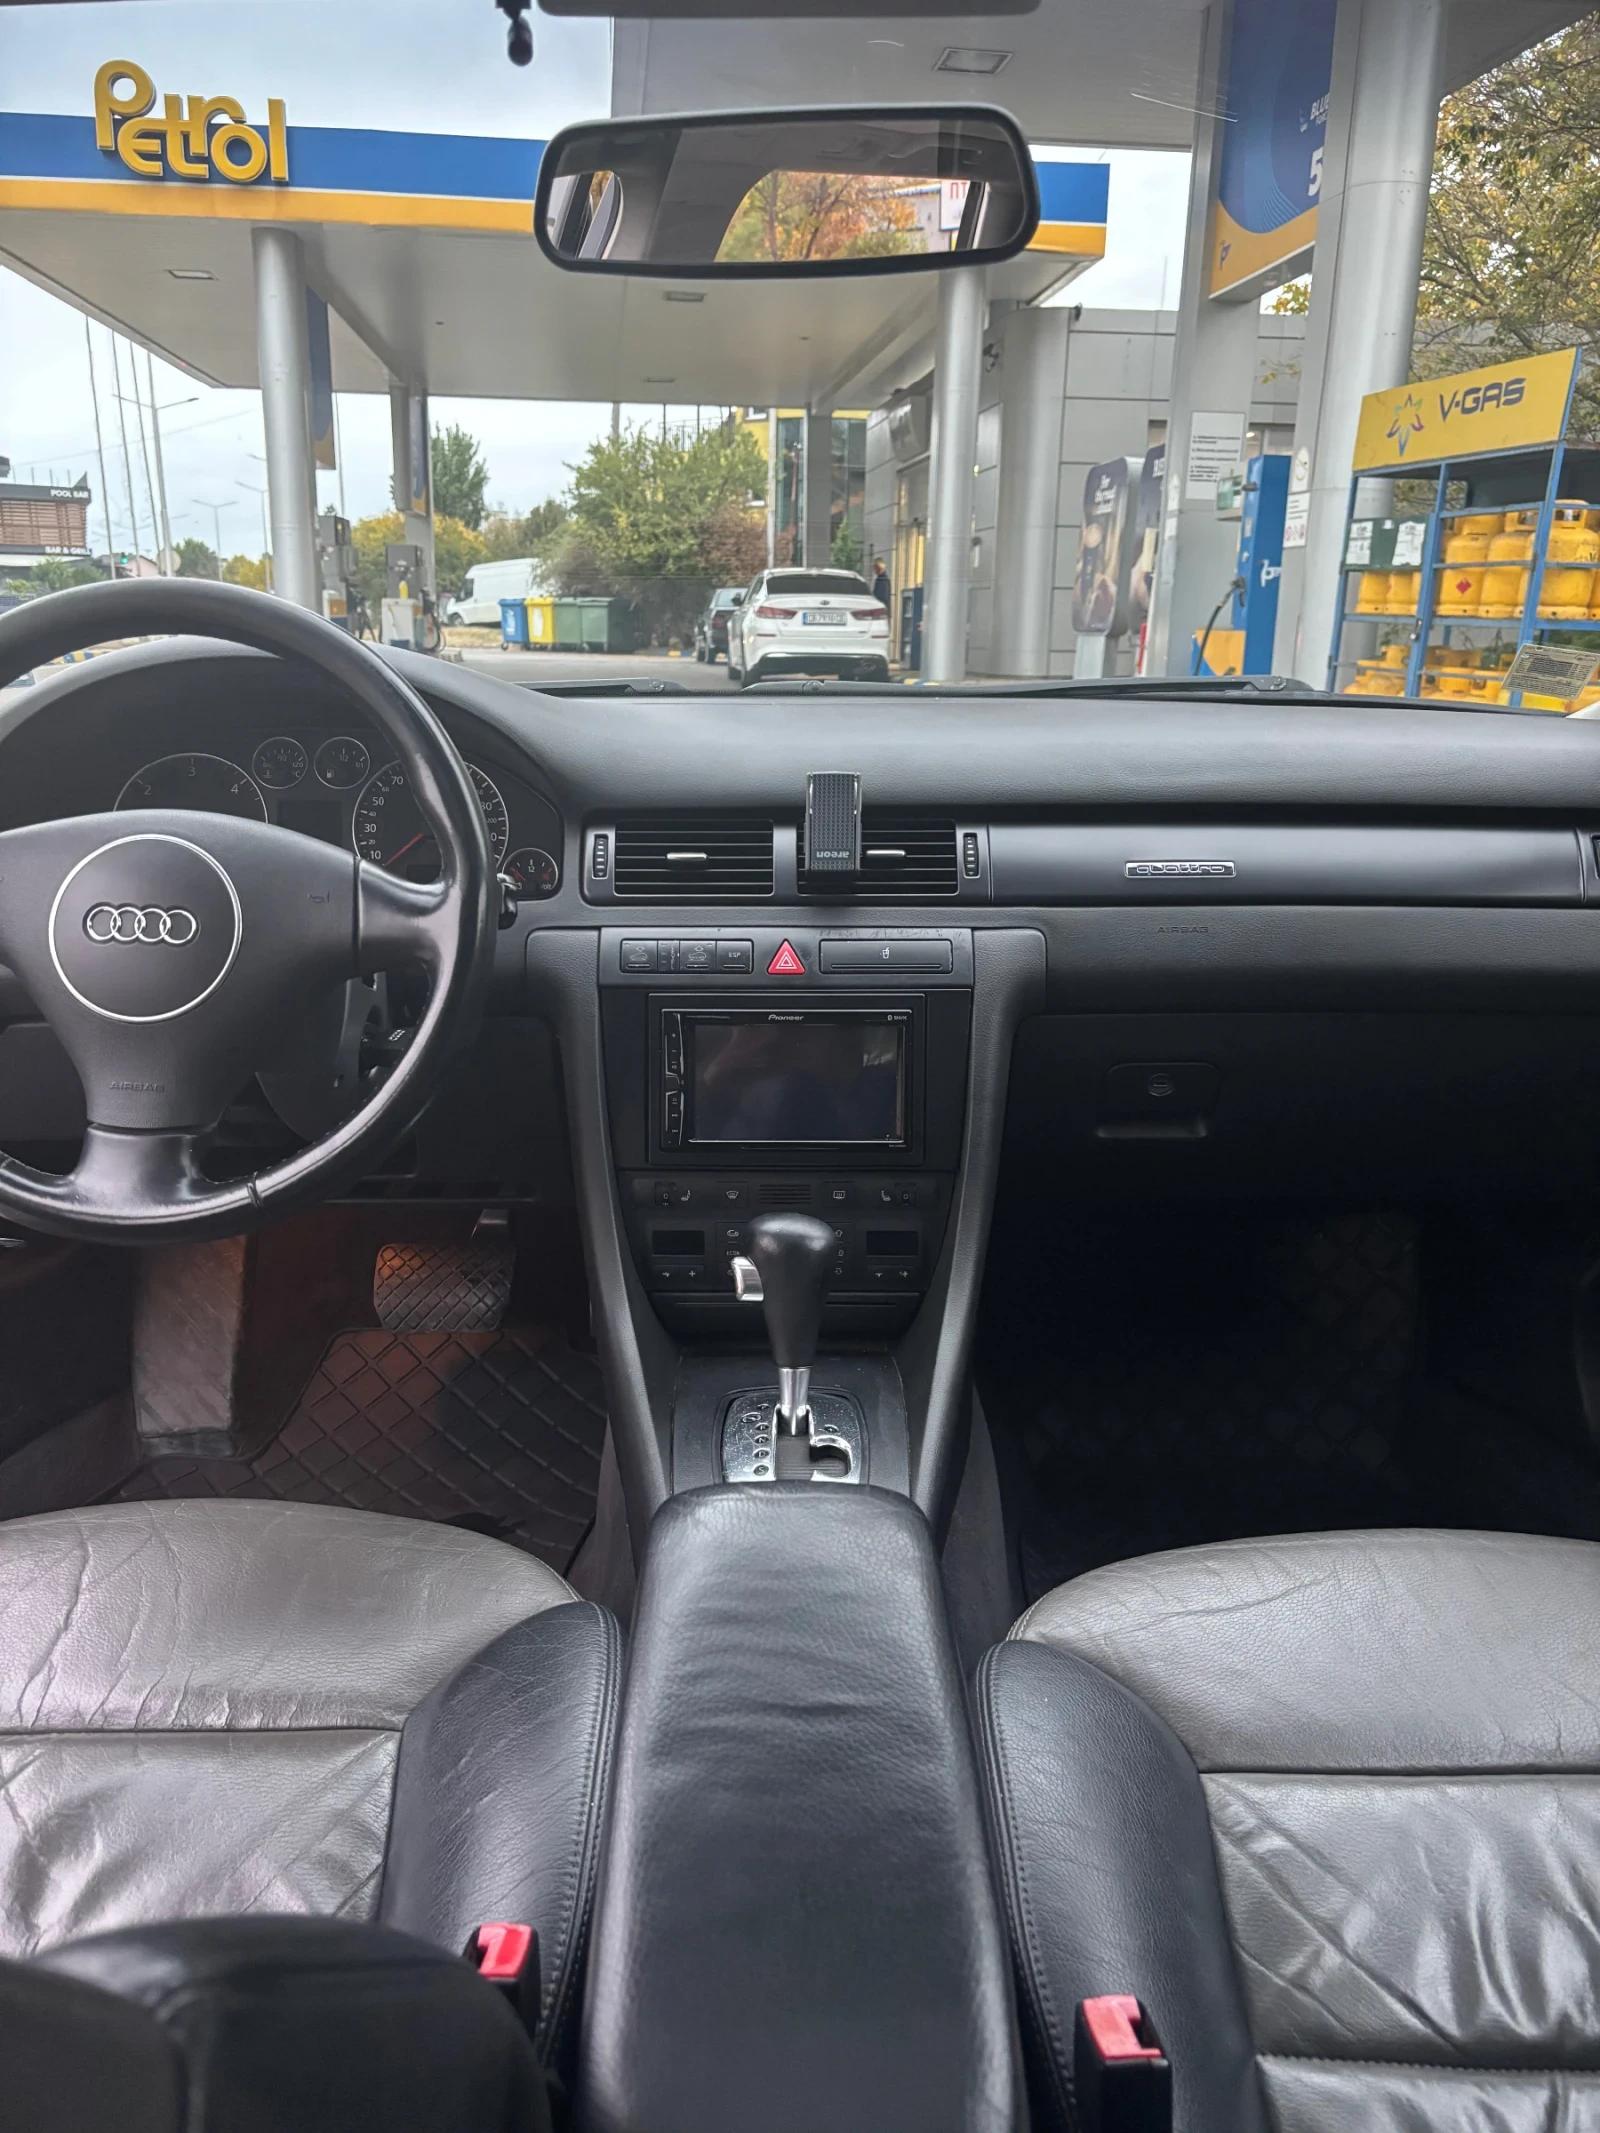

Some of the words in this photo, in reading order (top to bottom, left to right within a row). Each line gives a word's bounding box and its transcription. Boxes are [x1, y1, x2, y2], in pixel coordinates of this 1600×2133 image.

[94, 59, 289, 183] Petrol
[1439, 377, 1526, 422] V-GAS
[50, 489, 72, 497] POOL
[73, 490, 89, 499] BAR
[188, 766, 196, 776] 3
[391, 776, 404, 785] 70
[144, 785, 152, 796] 2
[231, 784, 239, 794] 4
[372, 797, 385, 806] 50
[363, 823, 377, 833] 30
[370, 850, 382, 860] 10
[1136, 863, 1225, 876] quattro
[1157, 925, 1209, 933] AIRBAG
